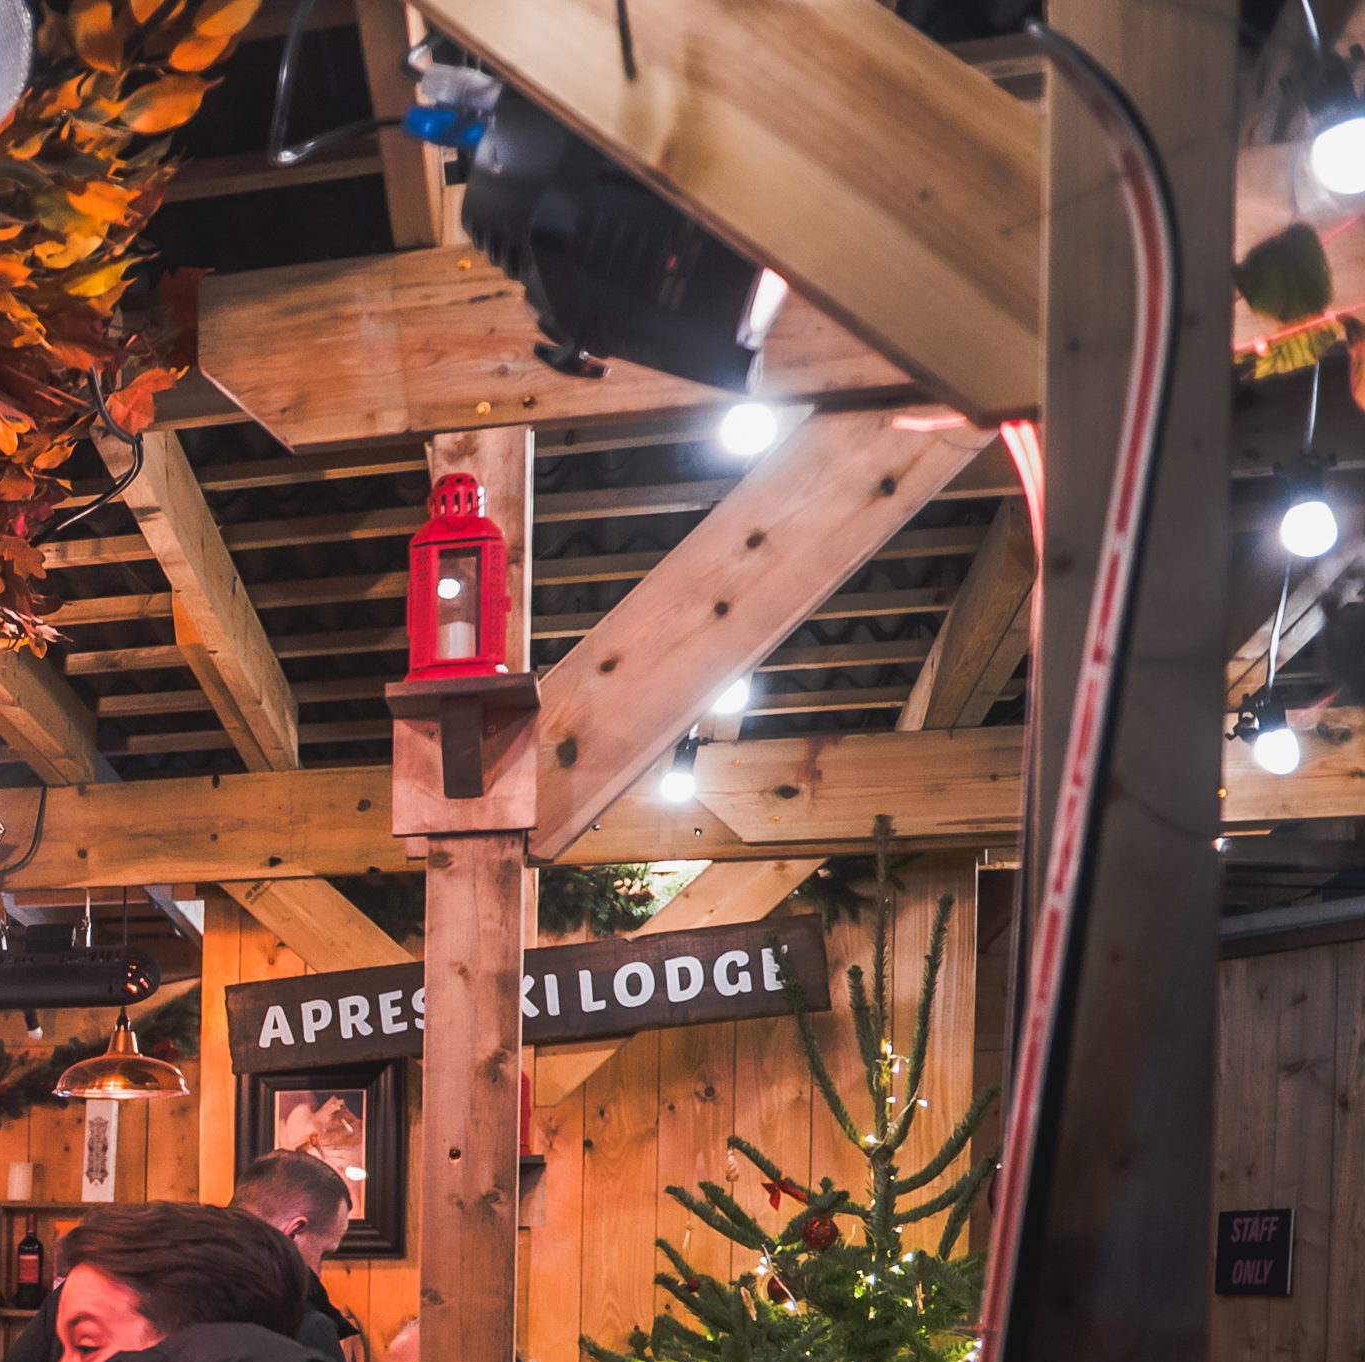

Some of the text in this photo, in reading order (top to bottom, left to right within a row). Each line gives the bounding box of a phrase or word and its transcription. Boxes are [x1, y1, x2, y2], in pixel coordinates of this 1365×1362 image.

[579, 945, 787, 1013] LODGE
[1230, 1215, 1280, 1242] STAFF
[1231, 1259, 1274, 1285] ONLY
